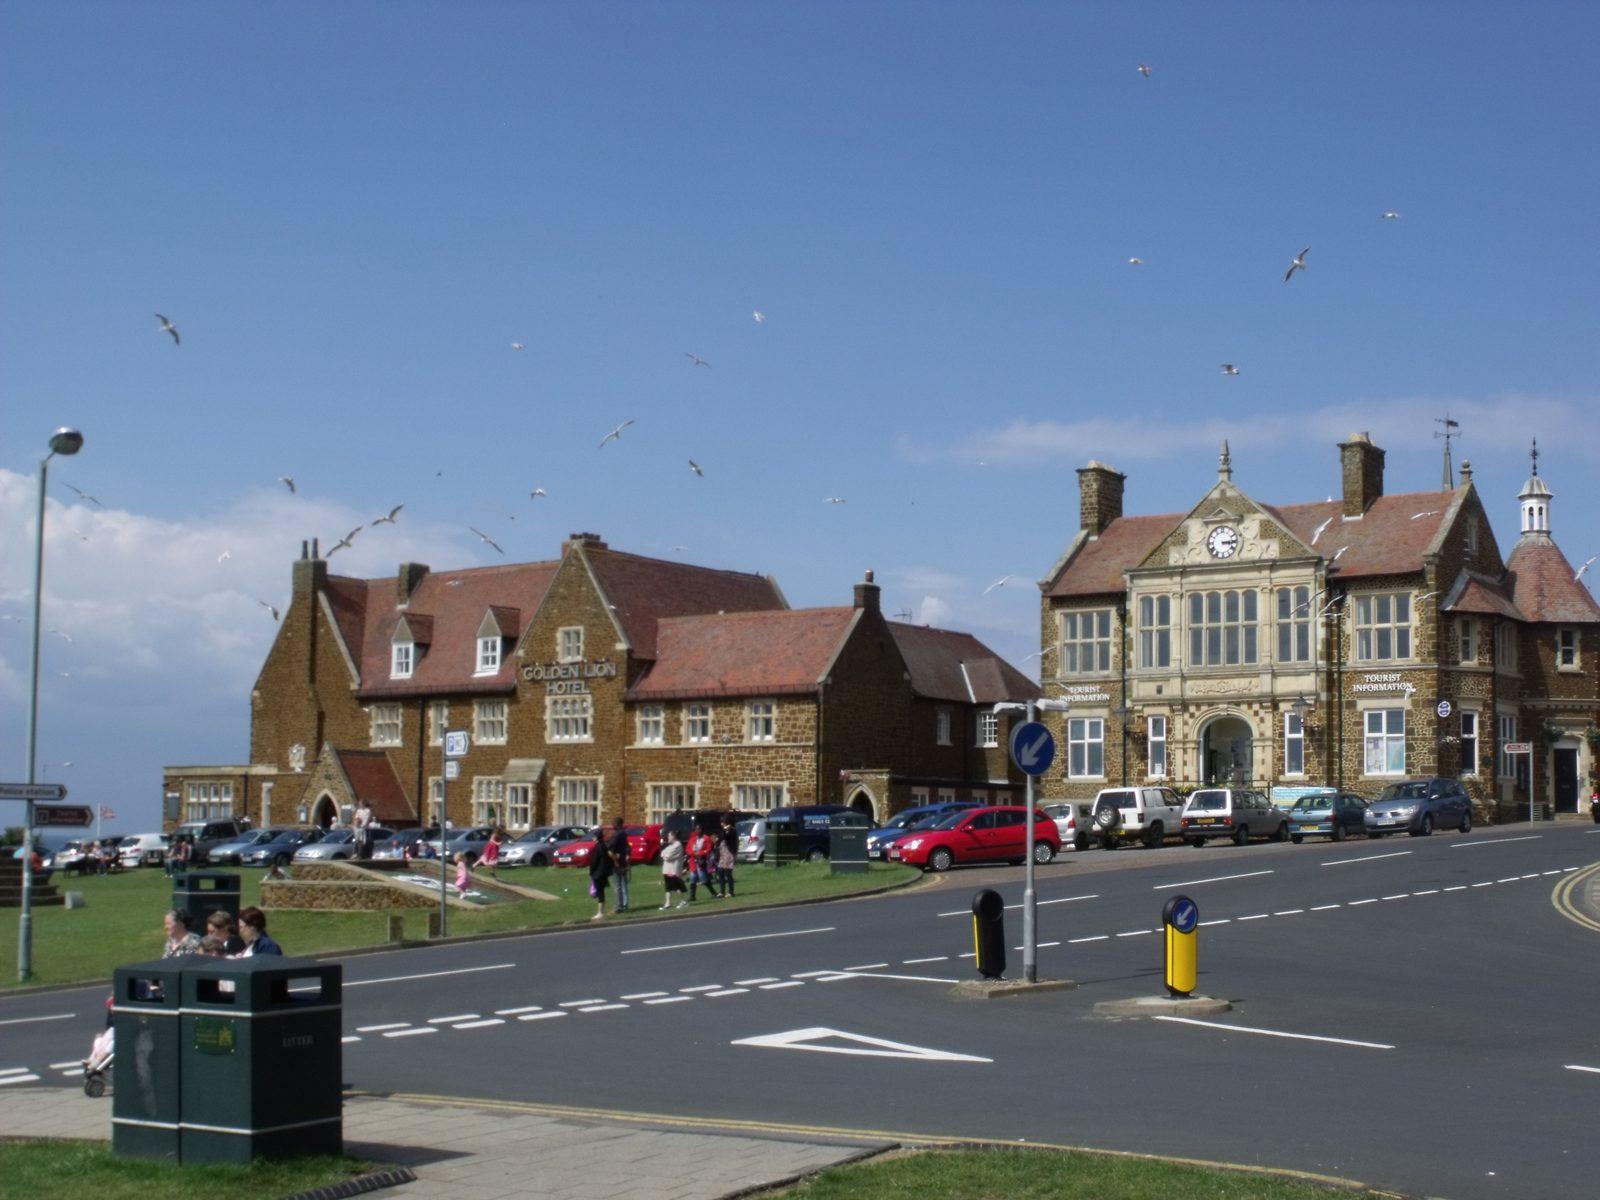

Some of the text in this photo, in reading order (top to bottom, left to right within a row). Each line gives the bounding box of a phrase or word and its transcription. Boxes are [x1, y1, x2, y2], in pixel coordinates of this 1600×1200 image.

[523, 661, 616, 680] GOLDEN LION
[1364, 673, 1402, 683] TOURIST
[546, 681, 591, 694] HOTEL
[1069, 685, 1101, 694] TOURIST
[1352, 682, 1413, 692] INFORMATION
[1059, 693, 1110, 702] INFORMATION
